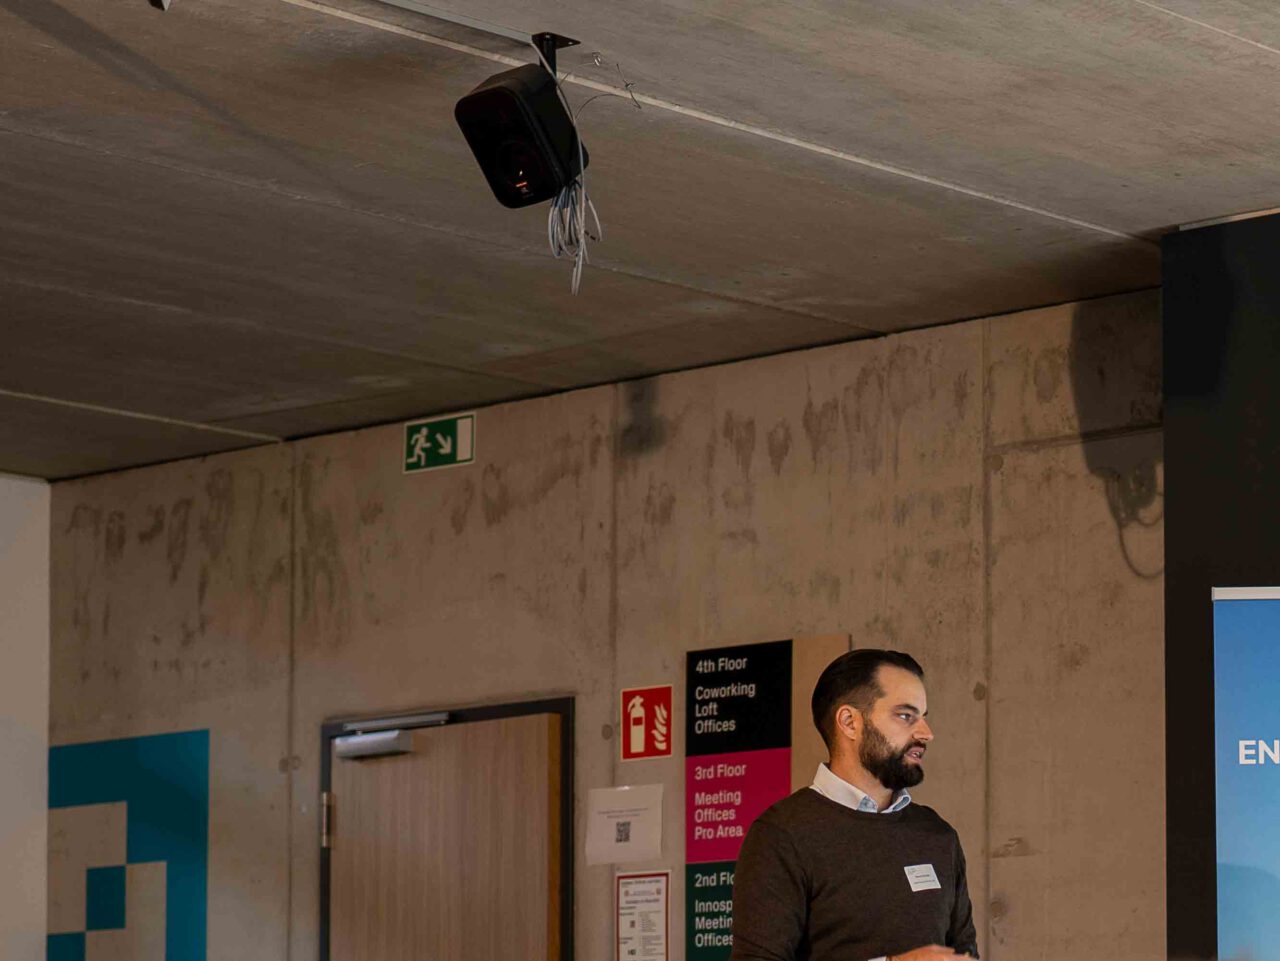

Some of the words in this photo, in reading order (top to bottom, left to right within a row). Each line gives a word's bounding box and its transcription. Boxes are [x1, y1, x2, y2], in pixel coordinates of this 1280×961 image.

[696, 659, 715, 673] 4th
[718, 657, 748, 672] Floor
[695, 682, 756, 700] Coworking
[695, 702, 718, 717] Loft
[695, 719, 736, 734] Offices
[695, 765, 714, 780] 3rd
[717, 763, 747, 778] Floor
[695, 790, 741, 806] Meeting
[695, 808, 736, 823] Offices
[695, 826, 714, 840] Pro
[716, 824, 744, 838] Area
[694, 872, 717, 887] 2nd
[720, 871, 735, 886] Flo
[695, 899, 733, 914] Innosp
[695, 915, 733, 930] Meetin
